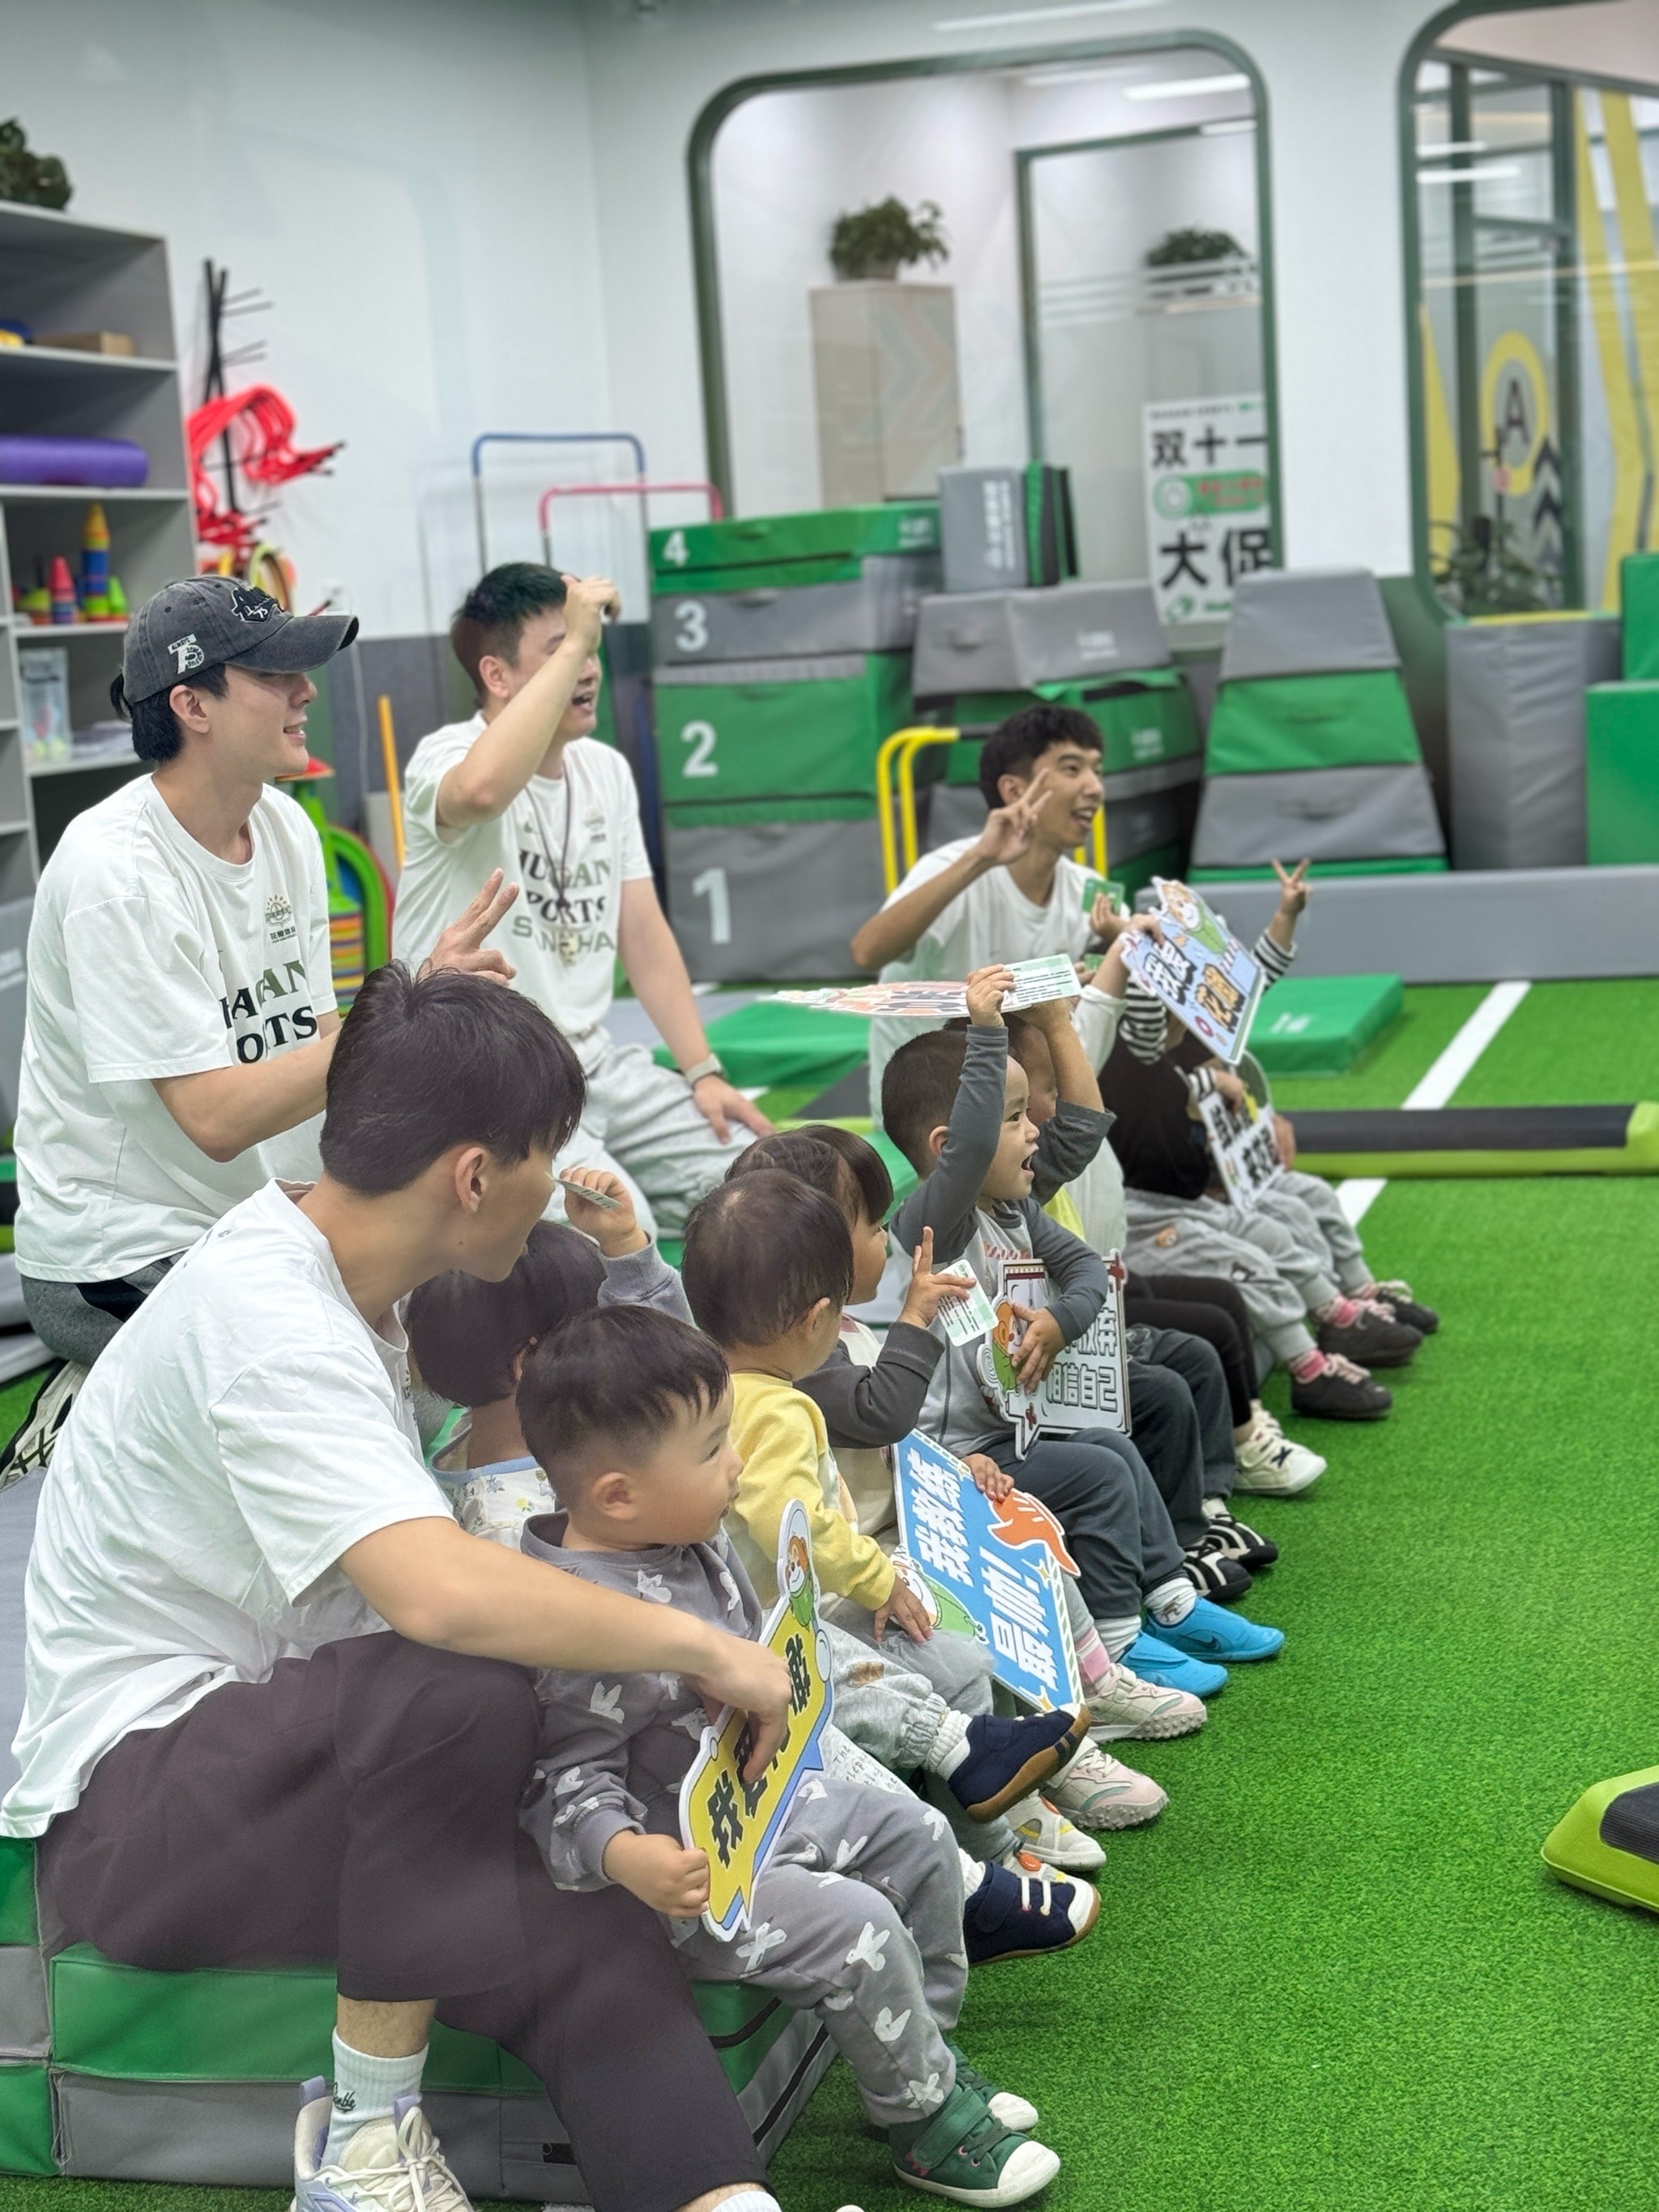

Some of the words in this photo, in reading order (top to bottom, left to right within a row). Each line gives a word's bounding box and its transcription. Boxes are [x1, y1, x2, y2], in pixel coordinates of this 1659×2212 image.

[1152, 426, 1268, 468] 双十一
[663, 531, 689, 566] 4
[674, 600, 709, 651] 3
[680, 720, 719, 778] 2
[692, 867, 731, 945] 1
[906, 1447, 975, 1588] 我教练
